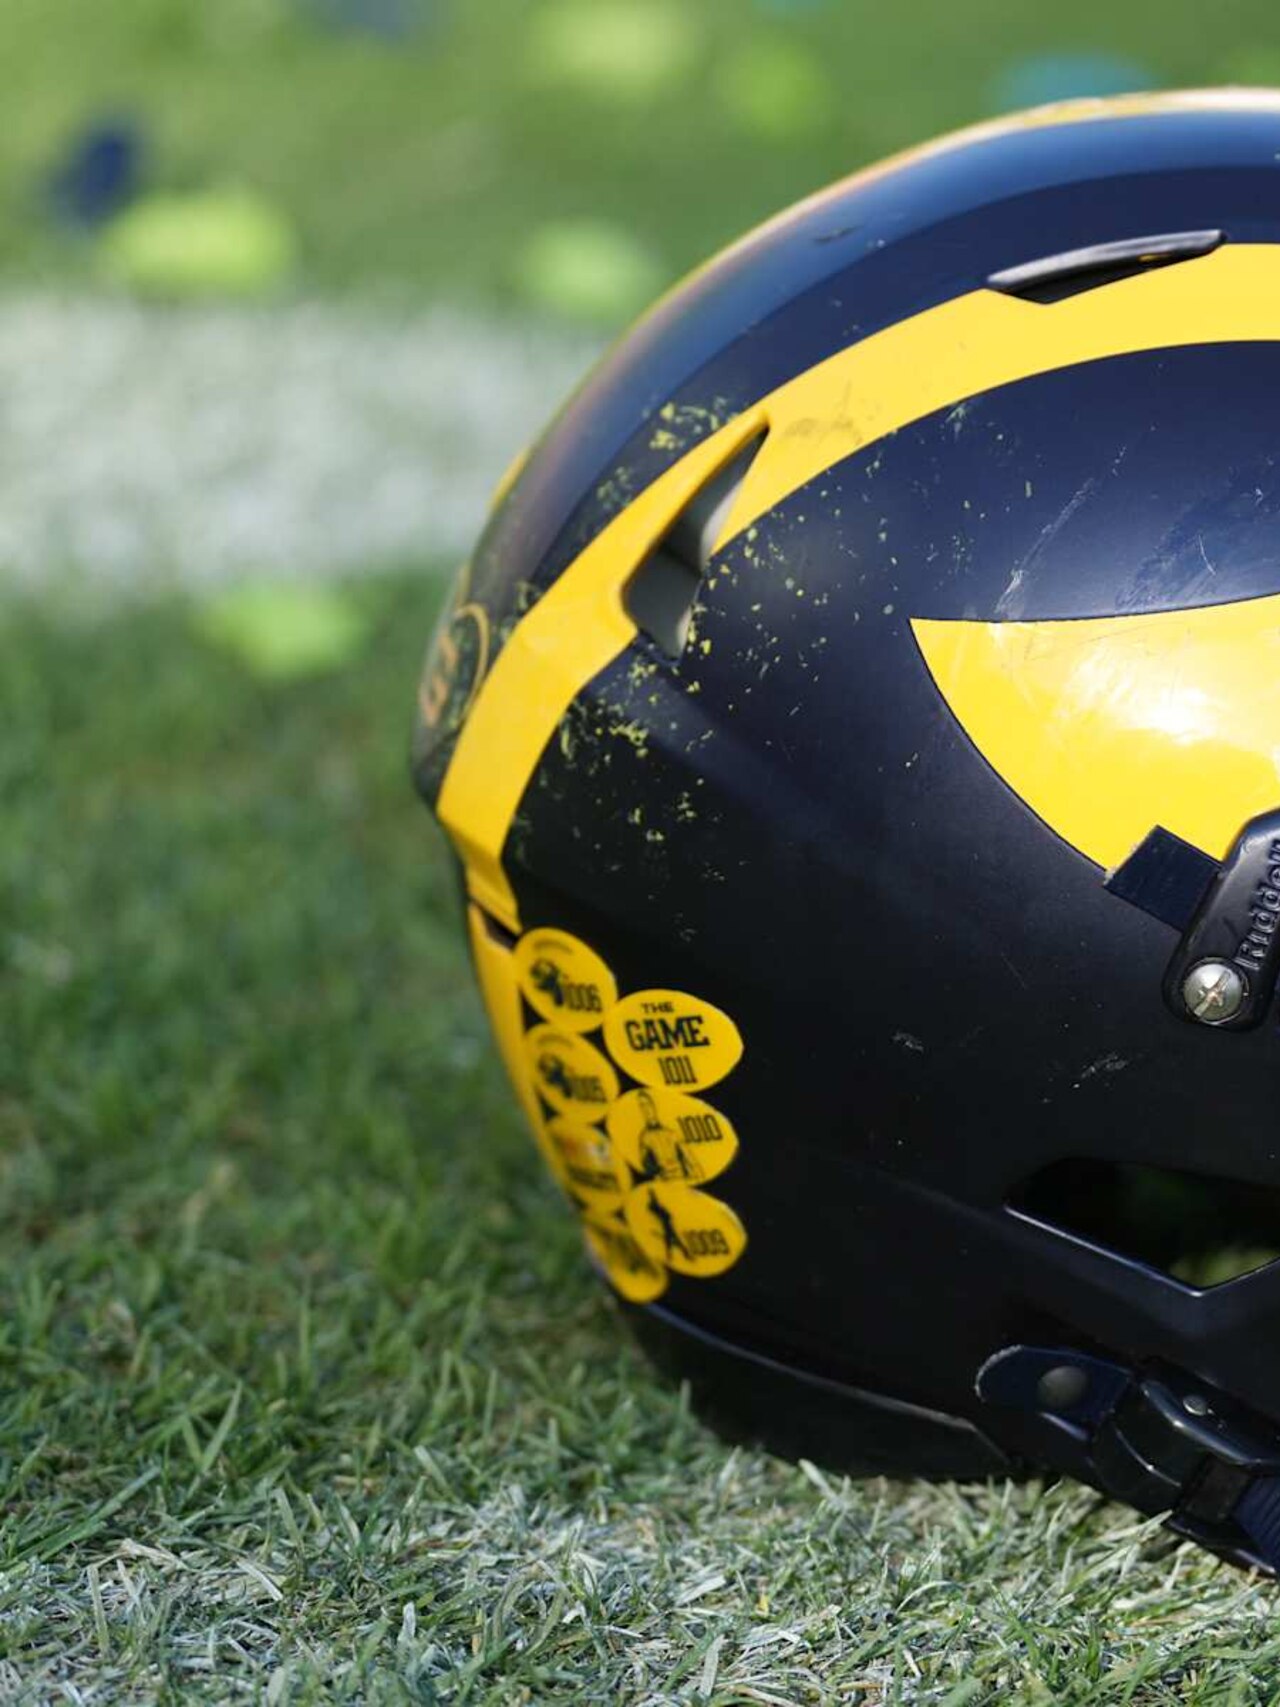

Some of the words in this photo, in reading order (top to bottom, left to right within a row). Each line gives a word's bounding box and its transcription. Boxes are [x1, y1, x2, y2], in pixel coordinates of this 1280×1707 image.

[641, 1002, 675, 1014] THE
[624, 1016, 710, 1051] GAME
[677, 1115, 723, 1144] 1010
